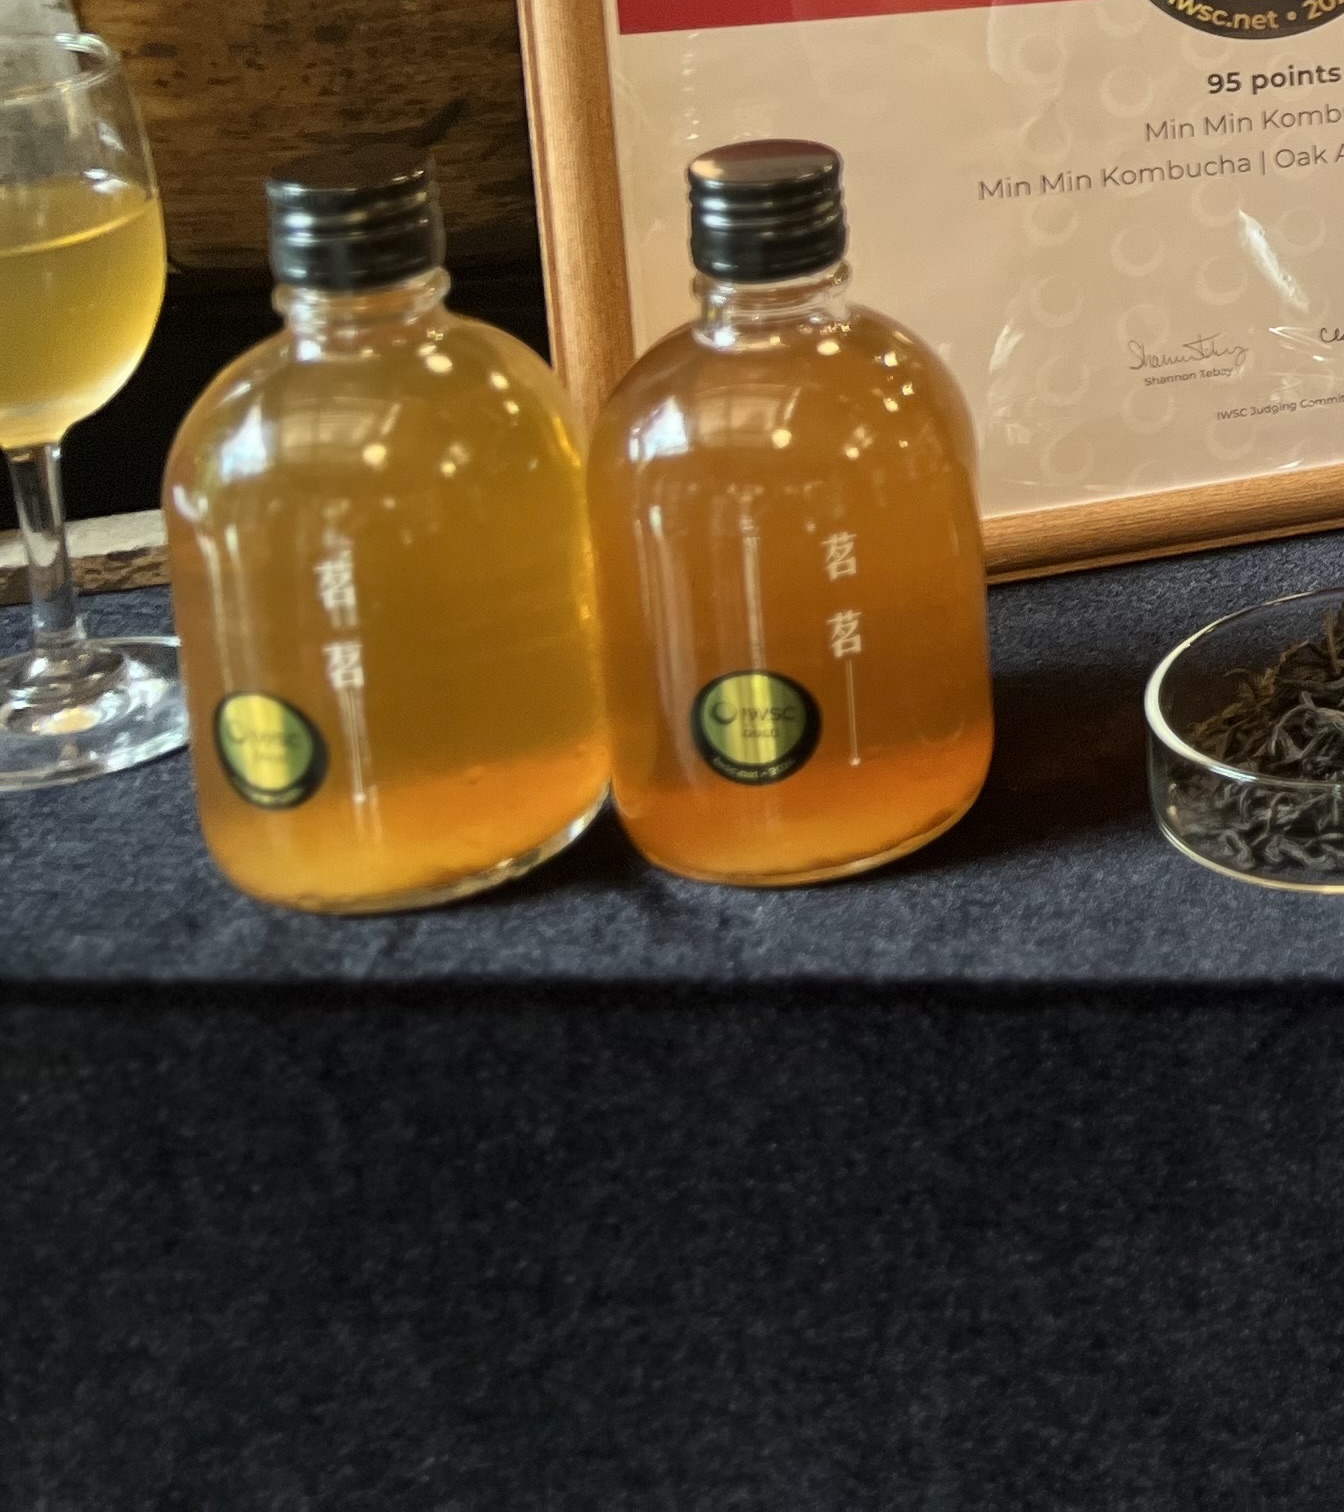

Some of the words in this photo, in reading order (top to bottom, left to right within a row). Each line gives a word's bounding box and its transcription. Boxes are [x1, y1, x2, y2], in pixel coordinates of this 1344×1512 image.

[1206, 71, 1242, 95] 95
[1251, 62, 1343, 95] points
[1145, 119, 1196, 143] Min
[1204, 111, 1254, 135] Min
[978, 177, 1031, 201] Min
[1039, 170, 1092, 196] Min
[1101, 153, 1253, 188] Kombucha
[1274, 143, 1329, 171] Oak
[1143, 371, 1197, 387] Shannon
[1199, 365, 1235, 380] Tebay
[1216, 407, 1248, 421] IWSC
[1250, 401, 1298, 418] Judging
[821, 531, 863, 659] 茗茗
[740, 705, 796, 722] IWSC
